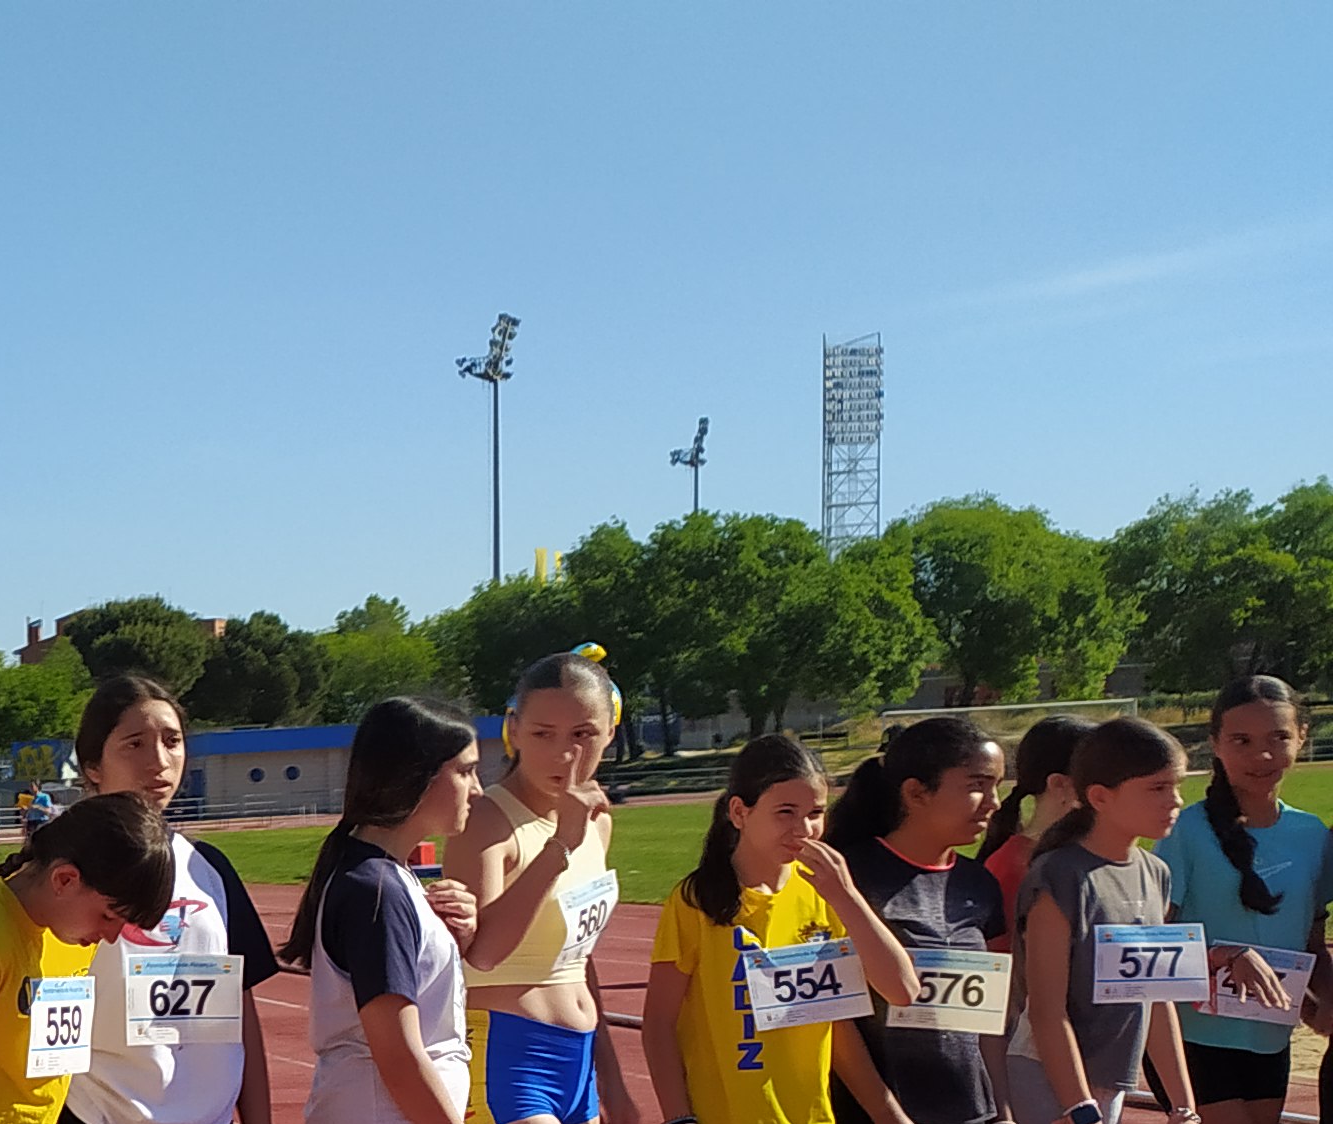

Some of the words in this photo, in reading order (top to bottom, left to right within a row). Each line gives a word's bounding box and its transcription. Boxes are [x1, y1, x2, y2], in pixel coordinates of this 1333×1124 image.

[576, 899, 608, 942] 560
[1118, 946, 1184, 978] 577
[149, 979, 216, 1017] 627
[773, 963, 843, 1003] 554
[919, 971, 986, 1007] 576
[46, 1005, 82, 1046] 559
